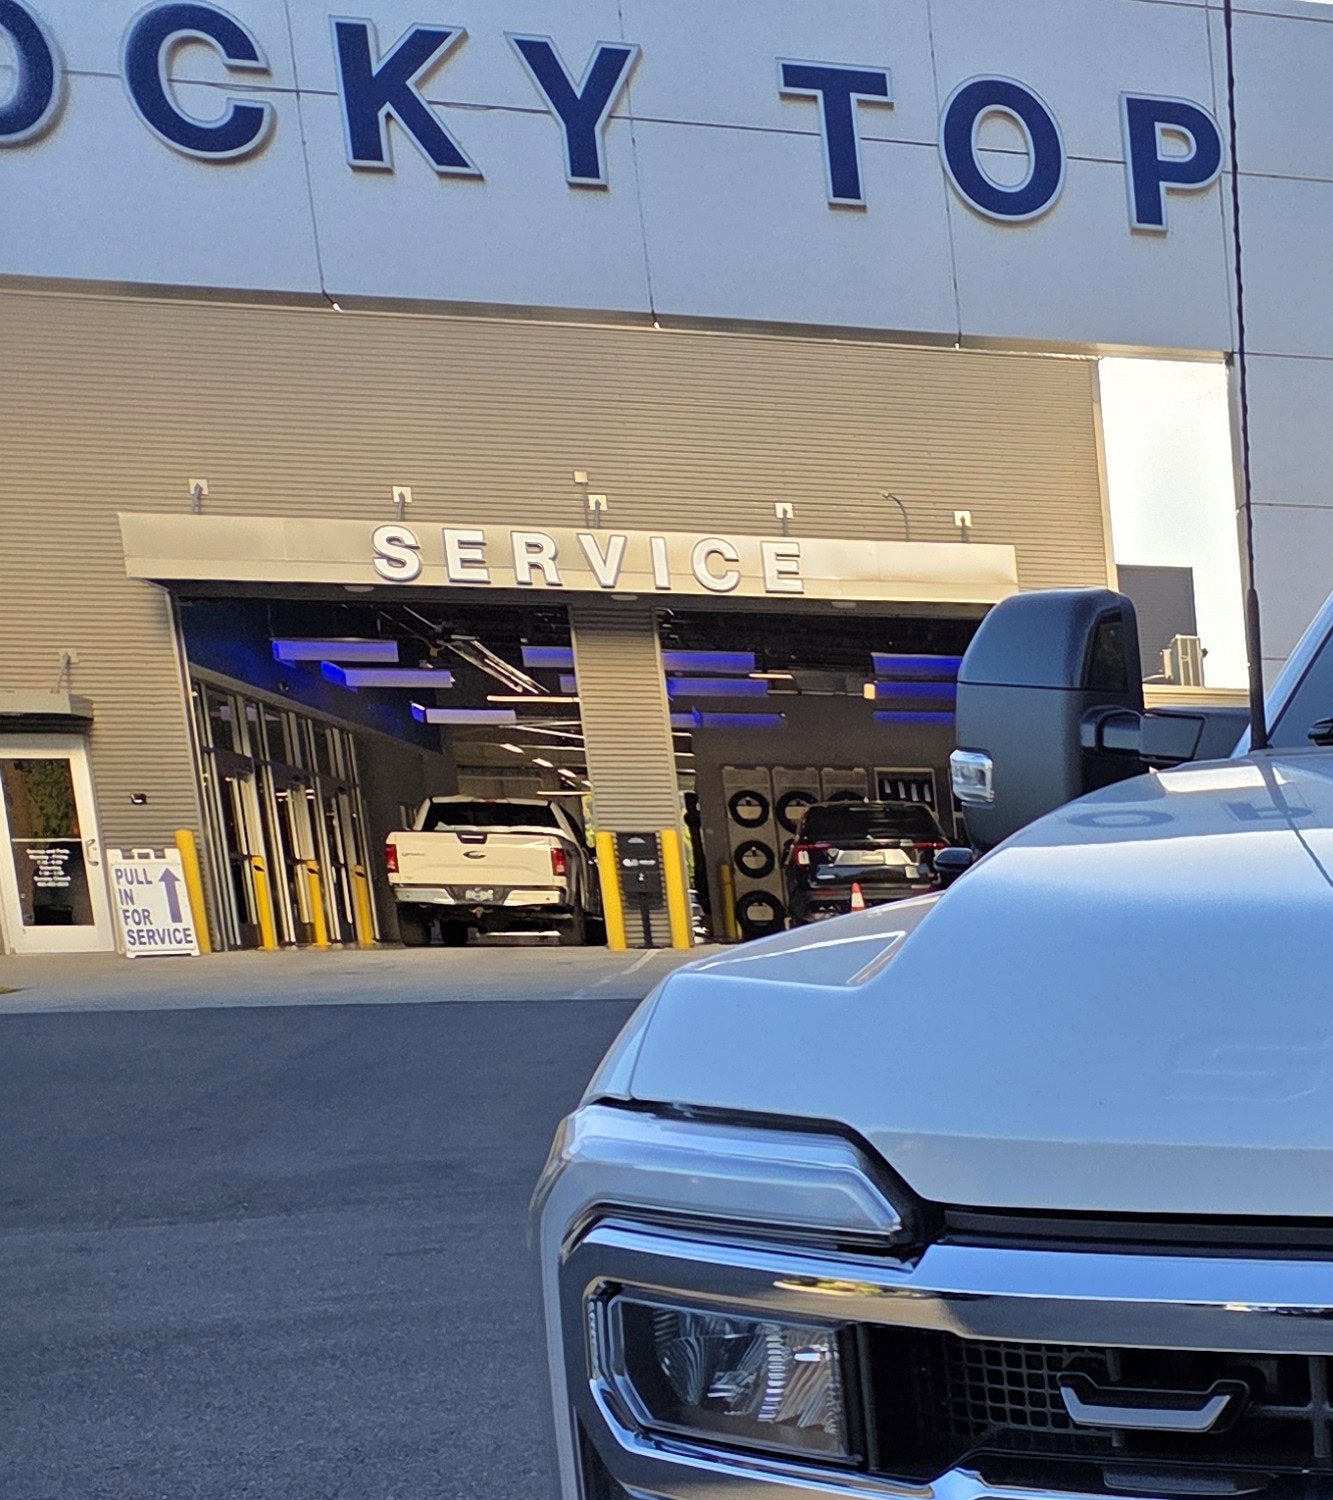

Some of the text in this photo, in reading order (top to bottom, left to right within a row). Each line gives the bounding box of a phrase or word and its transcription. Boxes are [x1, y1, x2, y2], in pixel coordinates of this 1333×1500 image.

[776, 56, 1225, 233] TOP
[371, 524, 805, 594] SERVICE
[114, 867, 153, 885] PULL
[118, 888, 135, 906] IN
[122, 908, 153, 926] FOR
[126, 927, 193, 946] SERVICE
